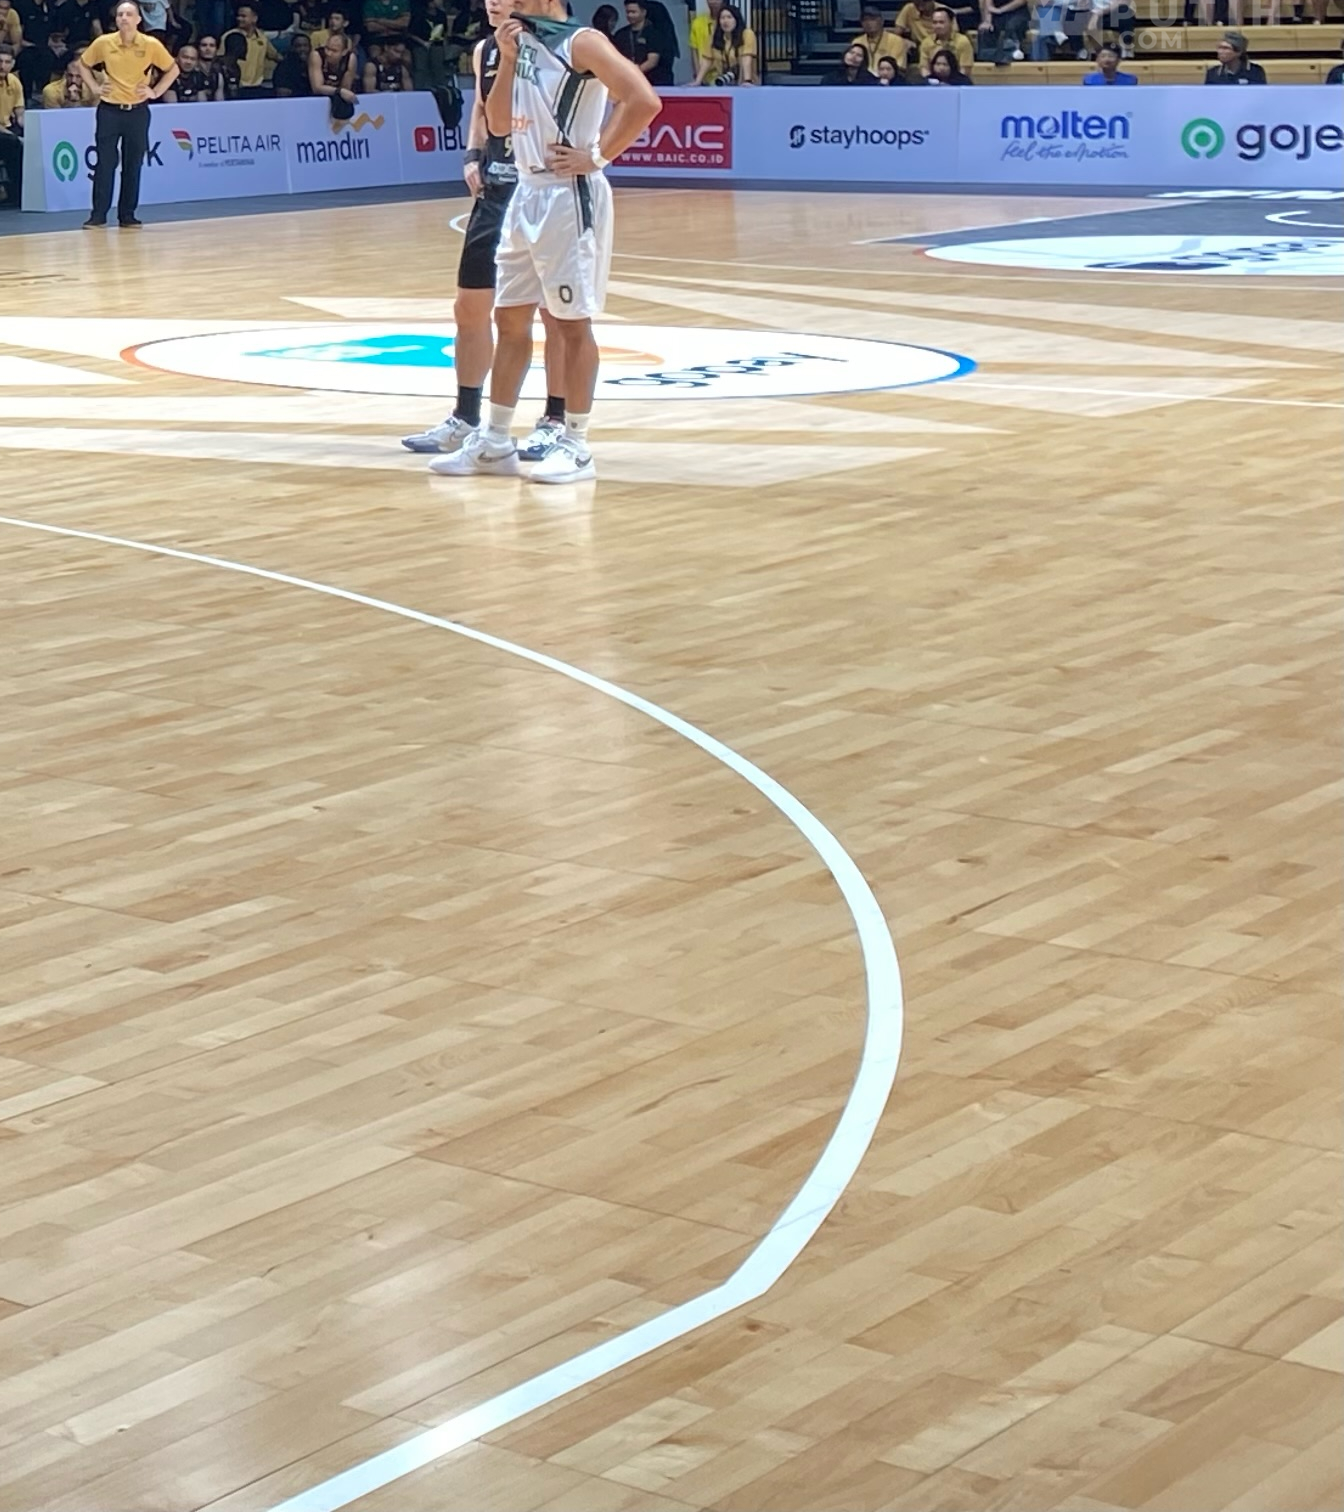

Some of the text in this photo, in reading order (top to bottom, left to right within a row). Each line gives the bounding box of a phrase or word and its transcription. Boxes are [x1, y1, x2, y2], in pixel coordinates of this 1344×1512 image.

[1000, 111, 1130, 140] molten
[196, 134, 282, 154] PELITA AIR
[296, 129, 370, 164] mandiri
[810, 126, 925, 149] stayhoops
[620, 152, 724, 165] WWW.BAIC.CO.ID
[559, 285, 573, 304] 0
